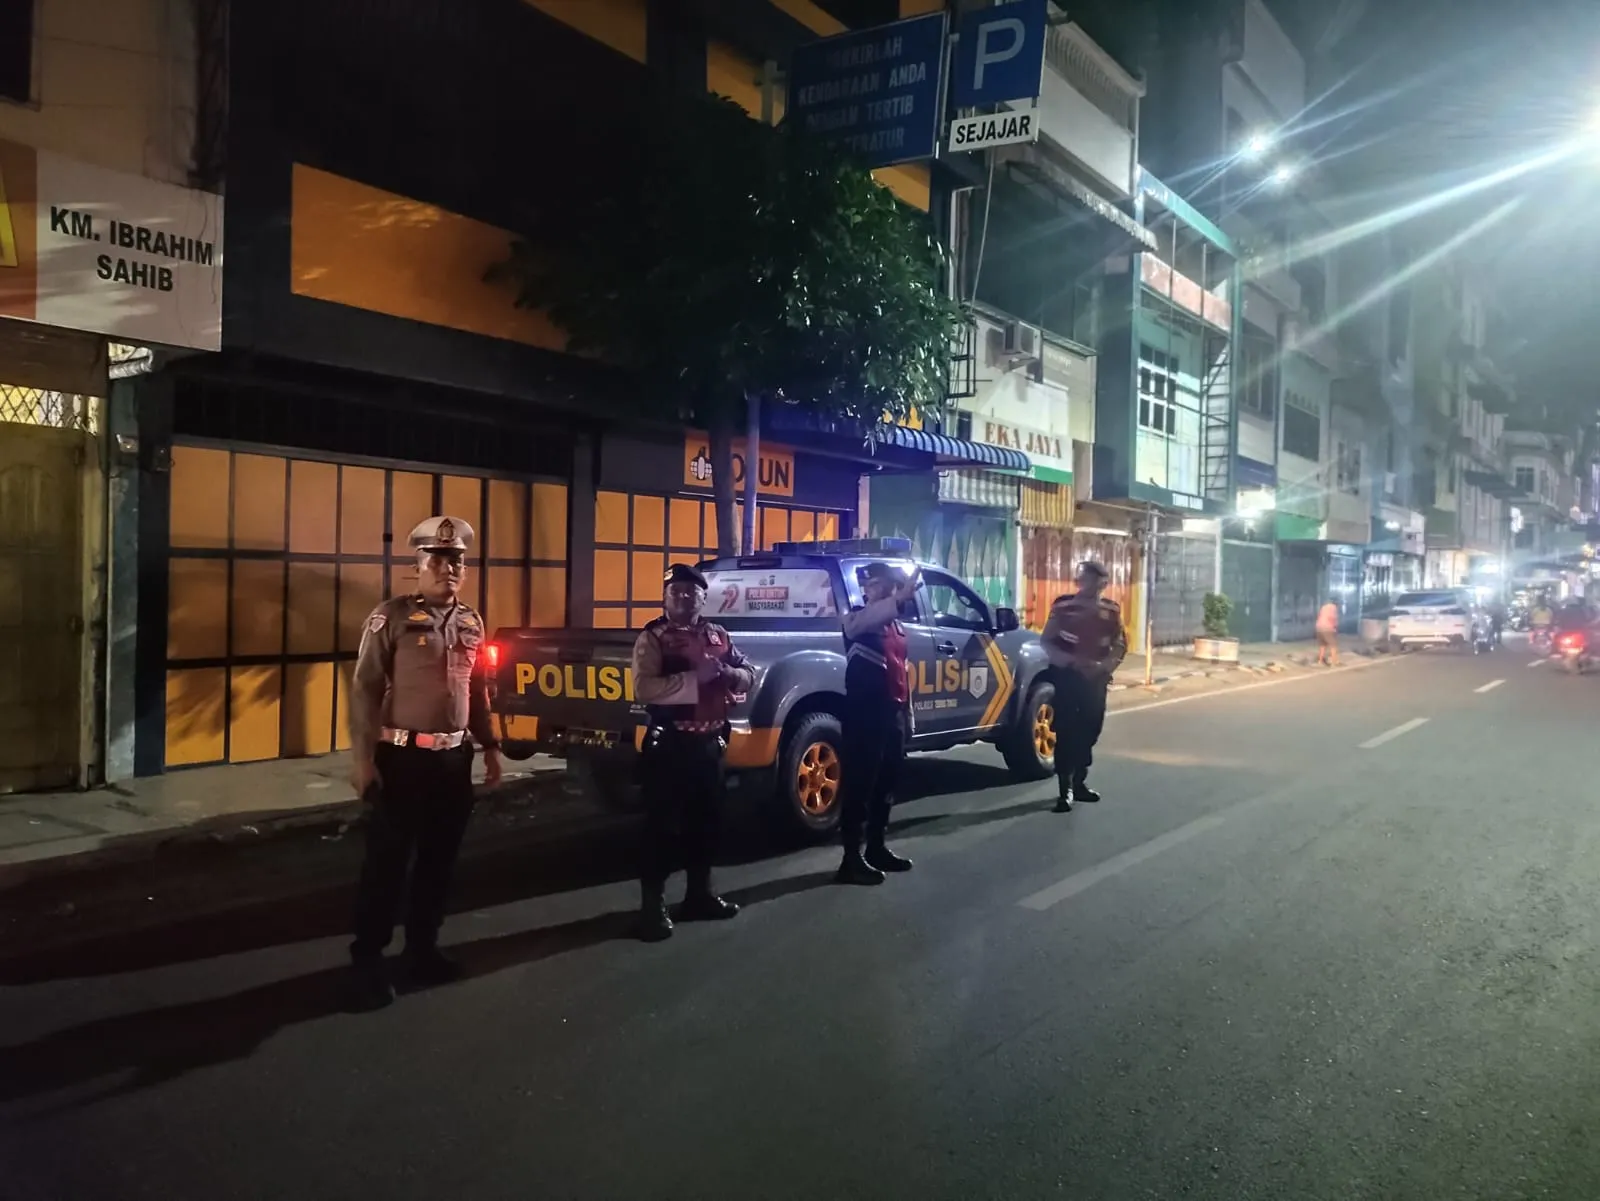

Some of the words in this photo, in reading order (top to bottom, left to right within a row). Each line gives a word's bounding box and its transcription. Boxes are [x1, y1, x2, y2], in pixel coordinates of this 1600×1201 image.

[973, 18, 1026, 90] P
[888, 61, 927, 89] ANDA
[866, 94, 915, 121] TERTIB
[955, 114, 1031, 145] SEJAJAR
[50, 205, 101, 242] KM.
[109, 219, 213, 266] IBRAHIM
[96, 253, 174, 292] SAHIB
[985, 421, 1022, 450] EKA
[1025, 431, 1062, 460] JAYA
[747, 600, 786, 611] MASYARAKAT
[515, 662, 635, 702] POLISI
